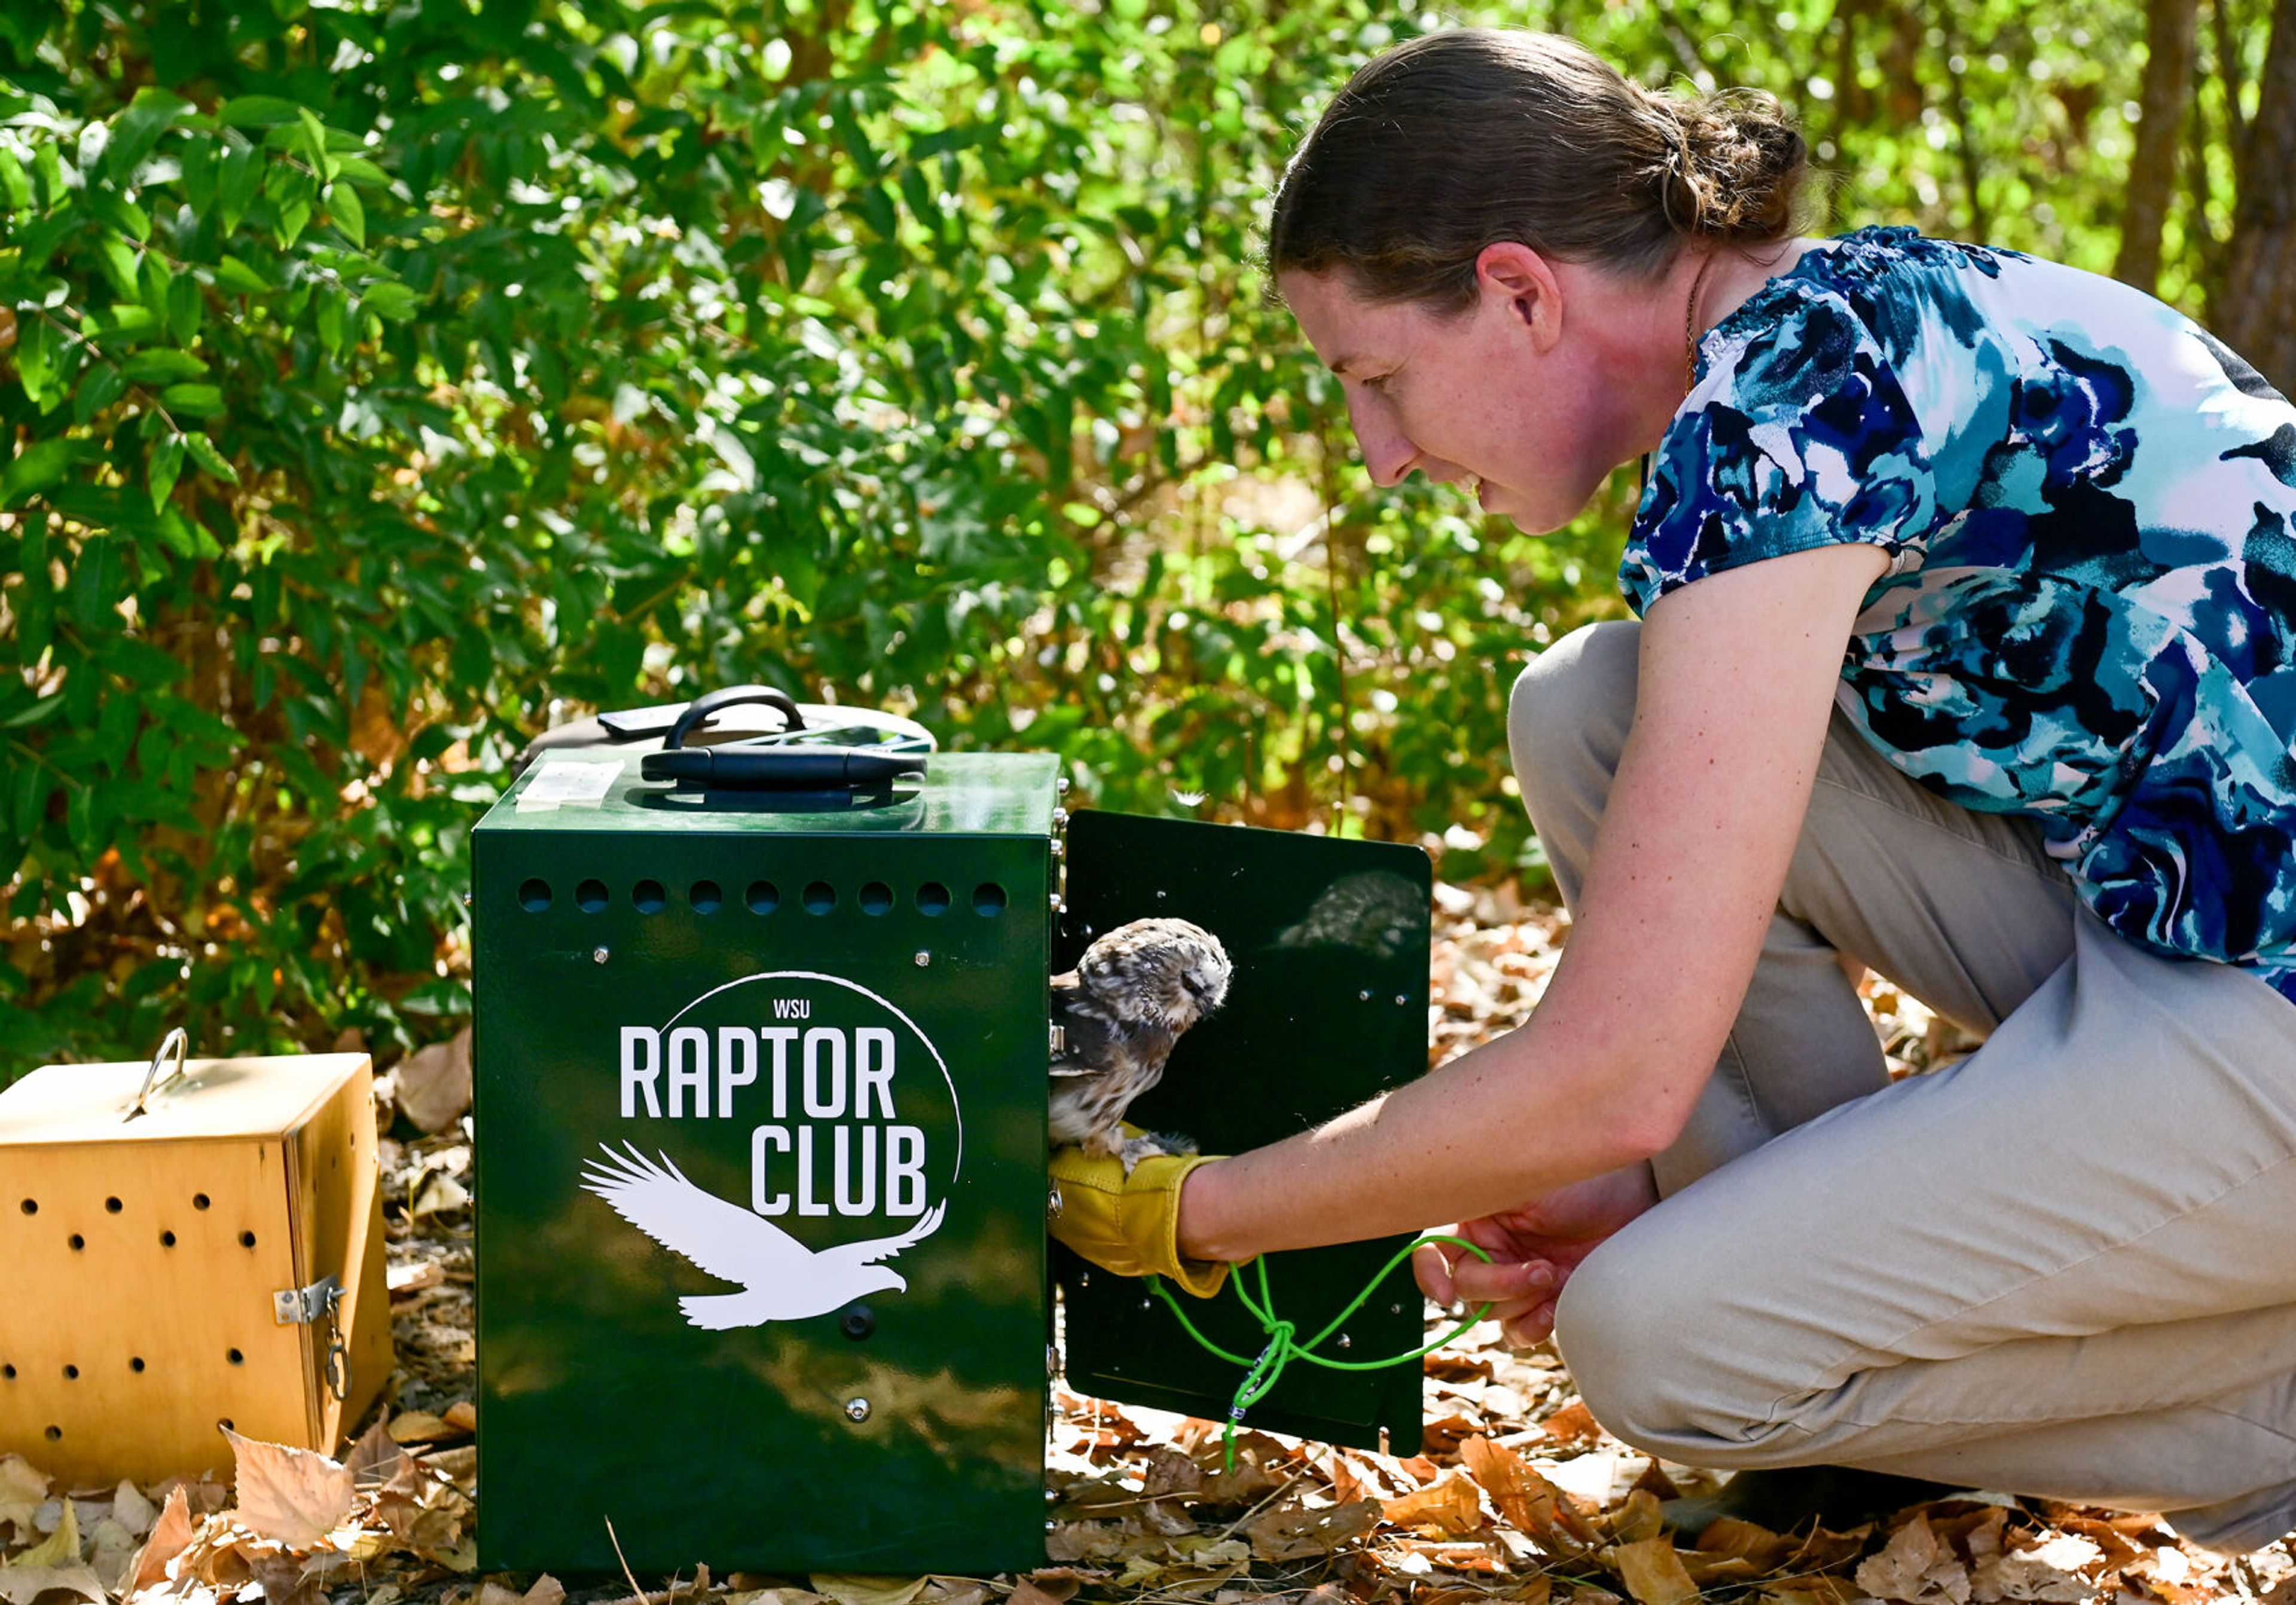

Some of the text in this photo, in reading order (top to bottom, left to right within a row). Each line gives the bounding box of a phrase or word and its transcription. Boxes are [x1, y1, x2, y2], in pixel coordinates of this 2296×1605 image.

[773, 999, 810, 1019] WSU
[620, 1026, 896, 1119] RAPTOR
[752, 1125, 926, 1216] CLUB
